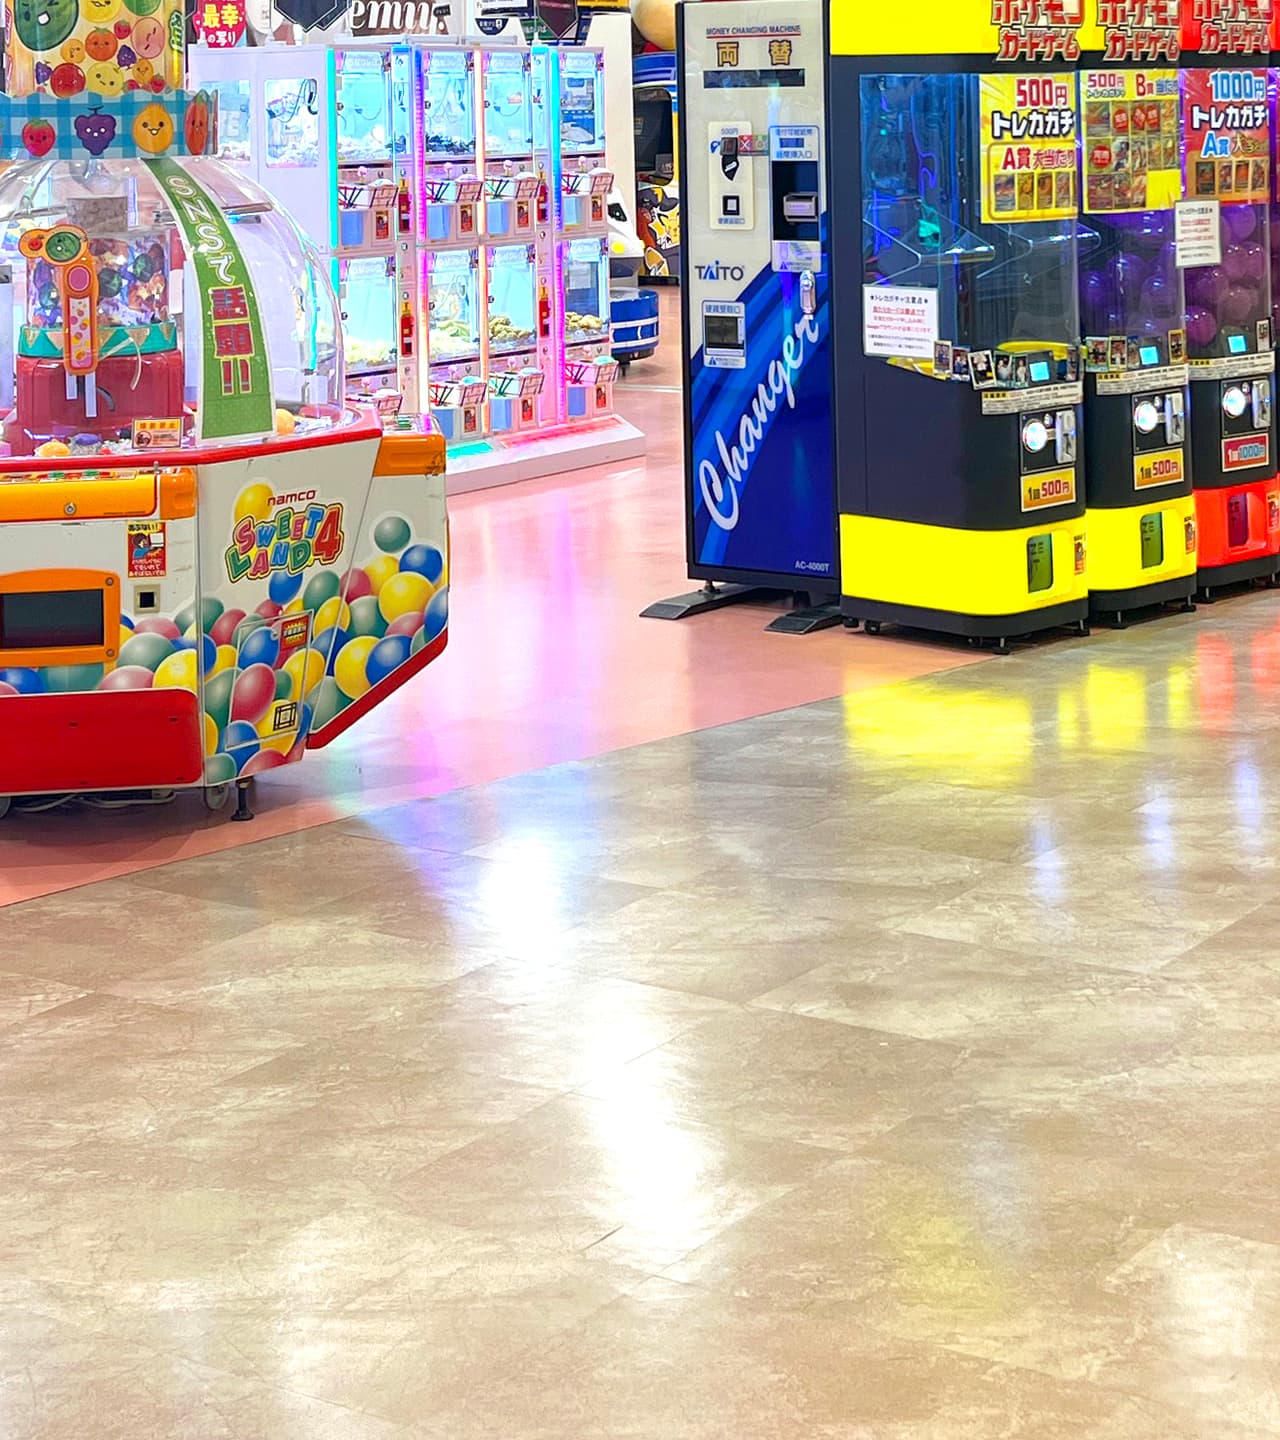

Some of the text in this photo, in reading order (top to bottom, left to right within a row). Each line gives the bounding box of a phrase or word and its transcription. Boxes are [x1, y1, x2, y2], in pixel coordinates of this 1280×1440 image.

[203, 3, 239, 28] 最幸
[716, 39, 792, 67] 両 替
[996, 28, 1081, 61] カードゲーム
[1104, 28, 1179, 61] カードゲーム
[1016, 77, 1068, 108] 500円
[1087, 73, 1125, 88] 500円
[1135, 73, 1154, 97] B賞
[1211, 71, 1266, 102] 1000円
[1001, 147, 1031, 170] A賞
[1201, 132, 1230, 158] A賞
[699, 315, 819, 531] Changer
[267, 489, 317, 507] namco
[234, 506, 342, 561] SWEET 4
[226, 538, 313, 580] LAND
